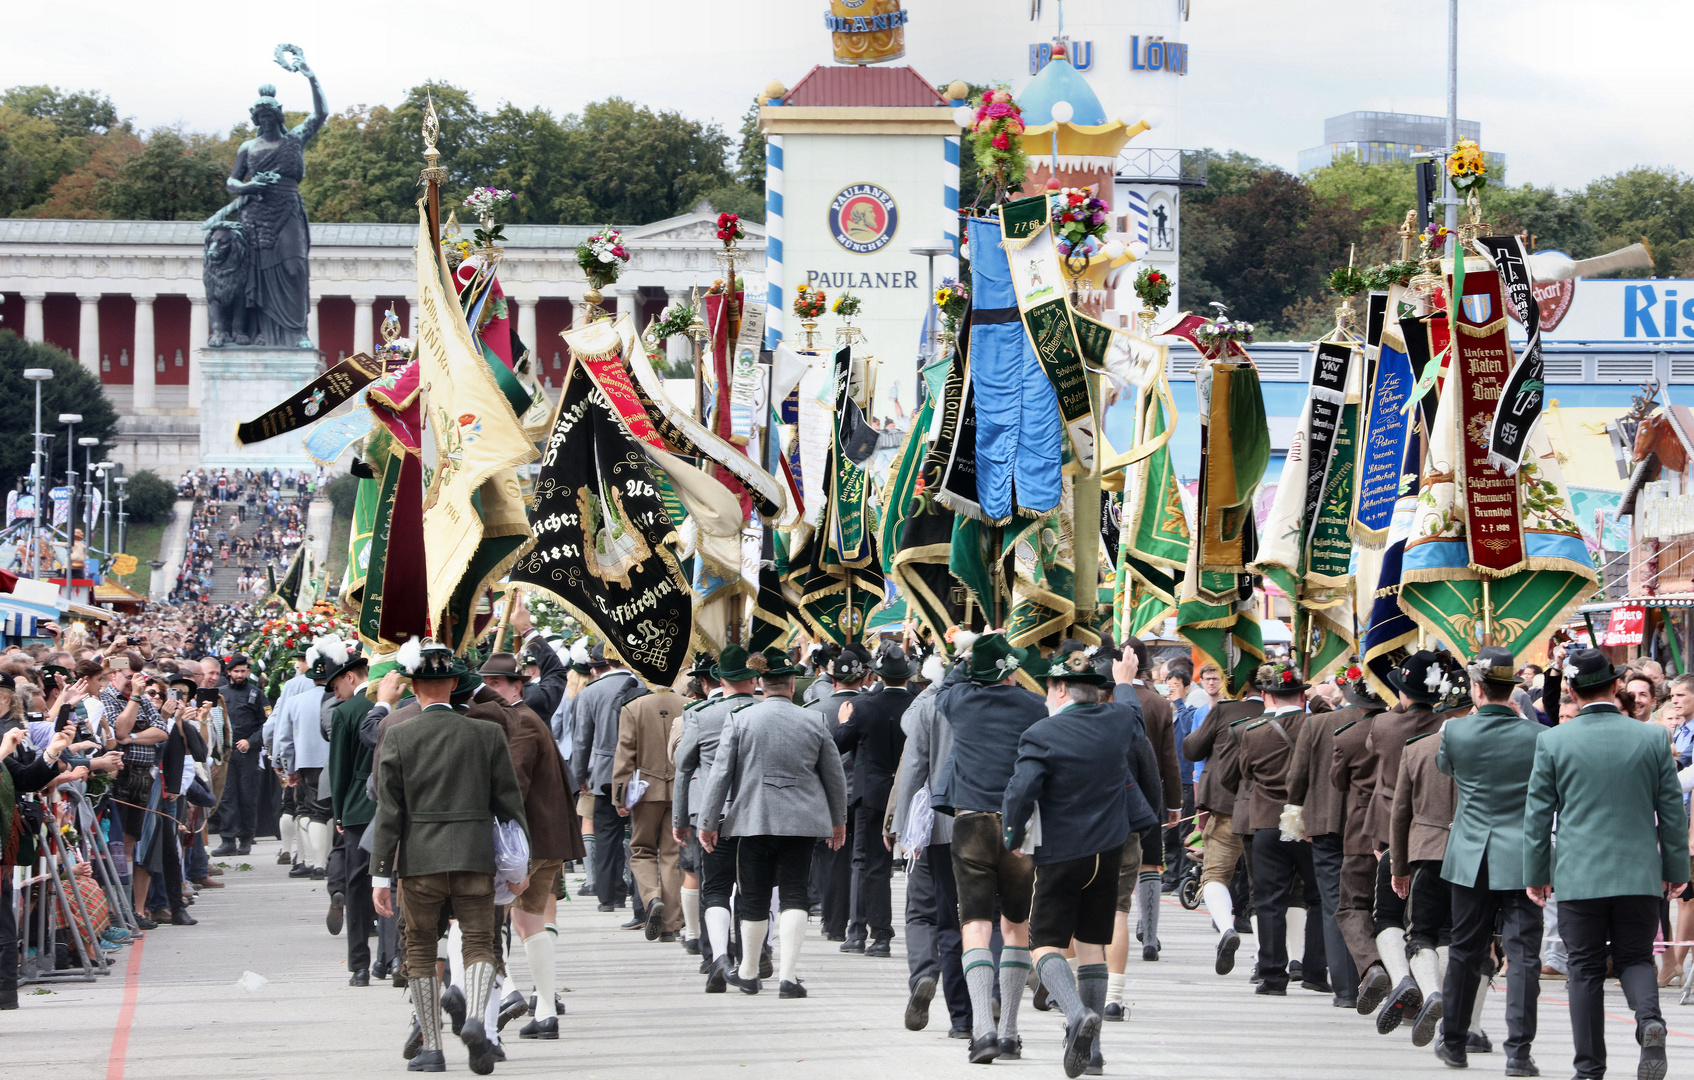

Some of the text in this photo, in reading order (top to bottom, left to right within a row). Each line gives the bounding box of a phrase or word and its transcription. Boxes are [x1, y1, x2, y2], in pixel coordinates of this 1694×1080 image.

[831, 185, 895, 211] PAULANER
[836, 233, 889, 253] MÜNCHEN
[806, 270, 918, 289] PAULANER
[1467, 357, 1504, 377] Paten
[1478, 376, 1497, 385] zum
[1471, 381, 1503, 401] Dank
[54, 490, 68, 498] WC
[540, 543, 580, 563] 1881
[595, 575, 677, 626] Tufkirchen!
